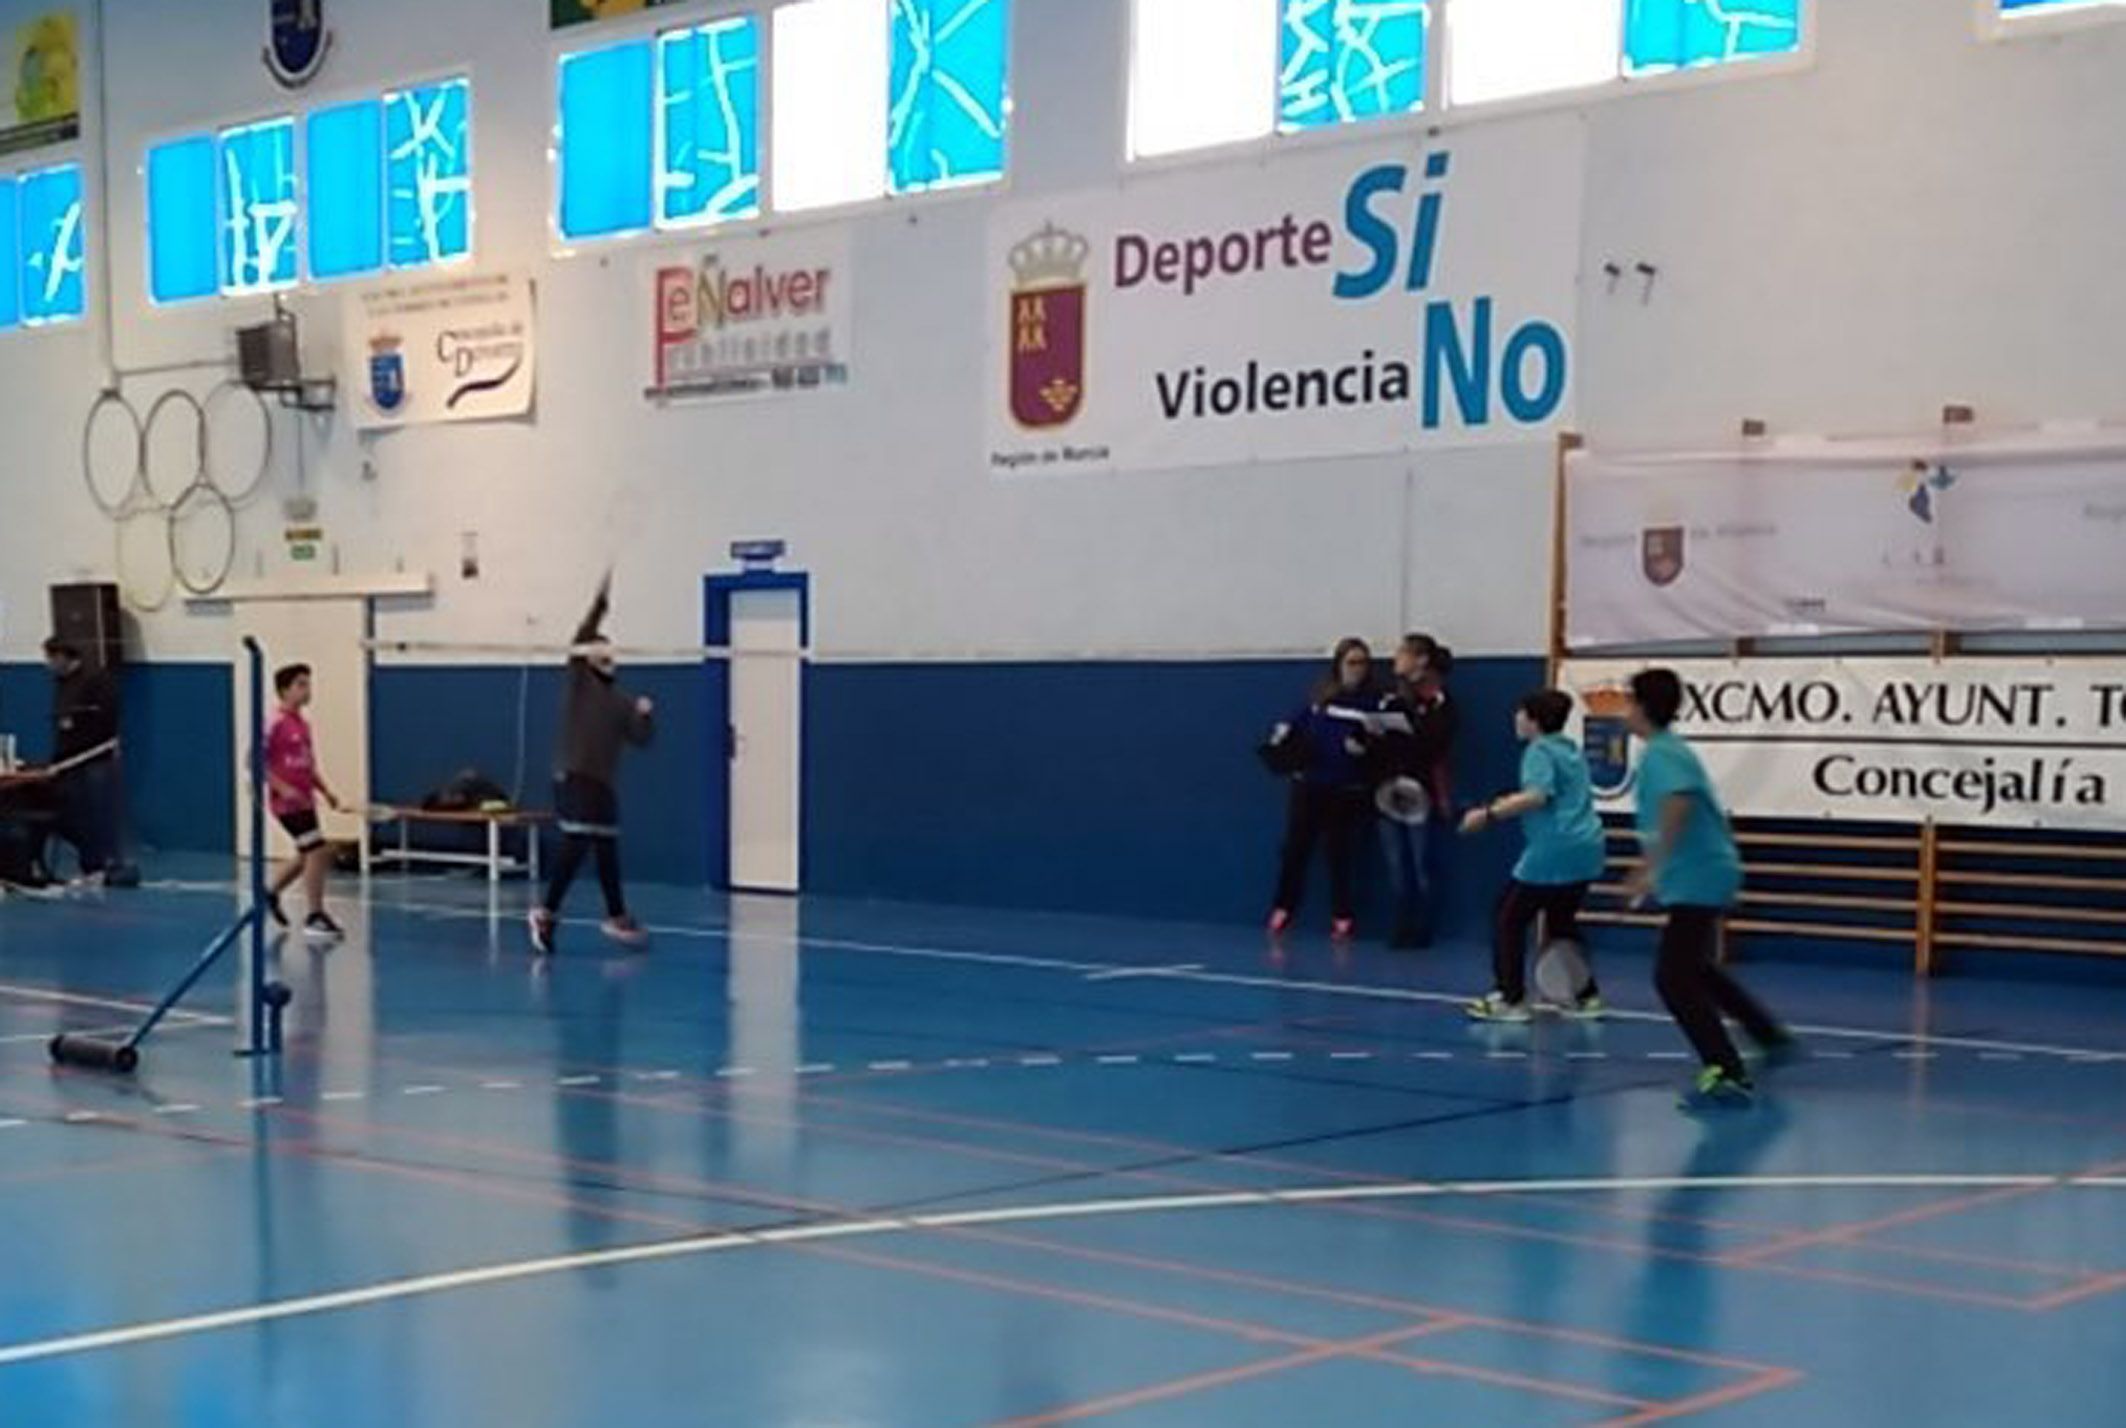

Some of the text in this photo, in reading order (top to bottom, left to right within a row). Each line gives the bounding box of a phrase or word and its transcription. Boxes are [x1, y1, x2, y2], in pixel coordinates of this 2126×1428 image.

[1114, 213, 1333, 296] Deporte
[1155, 295, 1568, 430] Violencia No
[1672, 681, 2126, 729] XCMO. AYUNT. T
[1812, 754, 2107, 815] Concejalía
